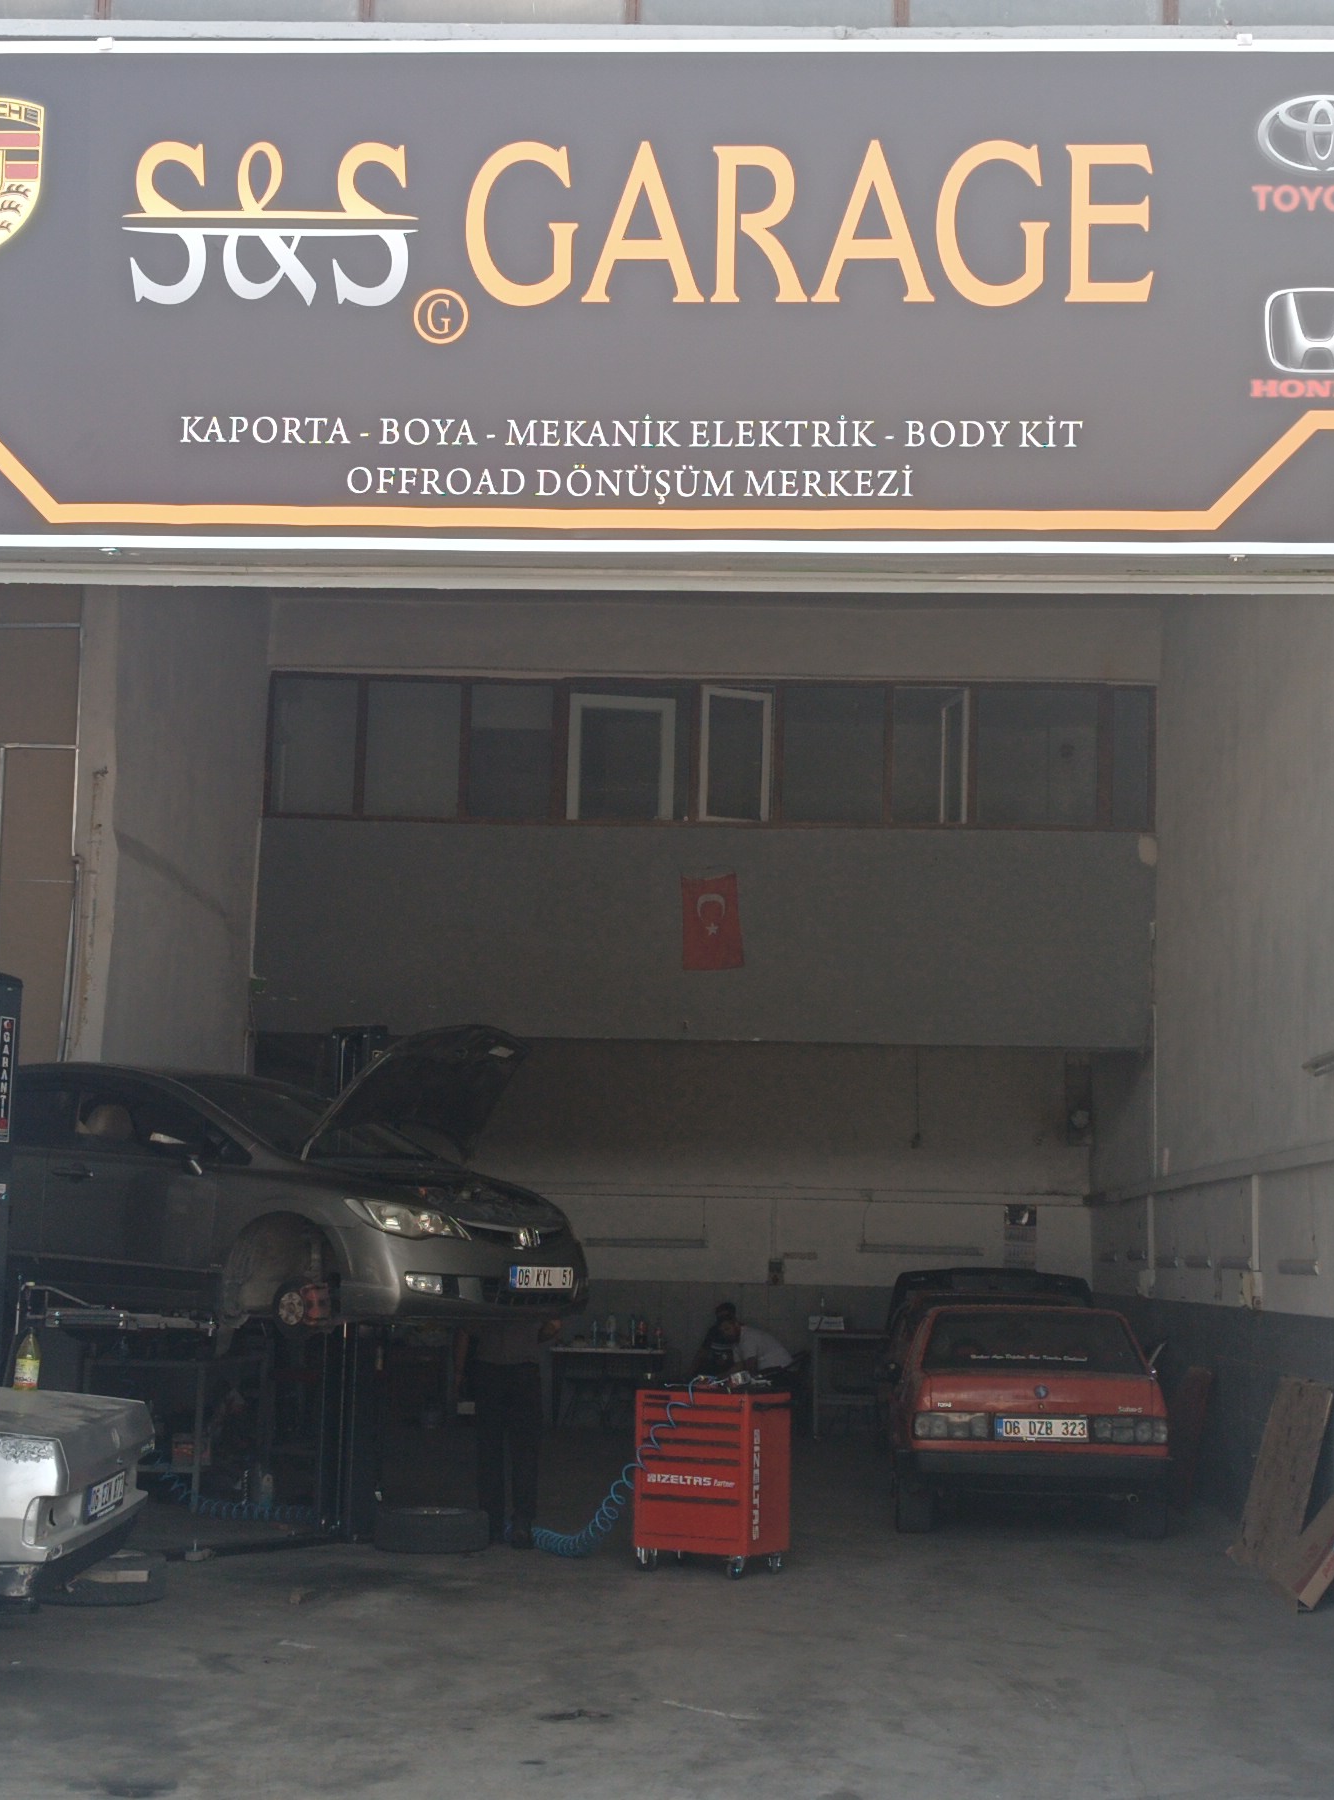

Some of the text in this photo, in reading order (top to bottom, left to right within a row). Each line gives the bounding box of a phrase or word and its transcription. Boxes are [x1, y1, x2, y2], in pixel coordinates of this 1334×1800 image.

[122, 139, 1154, 307] S&S GARAGE
[180, 416, 352, 445] KAPORTA
[380, 418, 477, 446] BOYA
[505, 414, 683, 448] MEKANİK
[689, 415, 876, 448] ELEKTRİK
[905, 419, 1011, 448] BODY
[1019, 415, 1084, 448] KİT
[346, 463, 914, 505] OFFROAD DÖNÜŞÜM MERKEZİ
[1004, 1420, 1020, 1436] 06
[1062, 1421, 1086, 1437] 323
